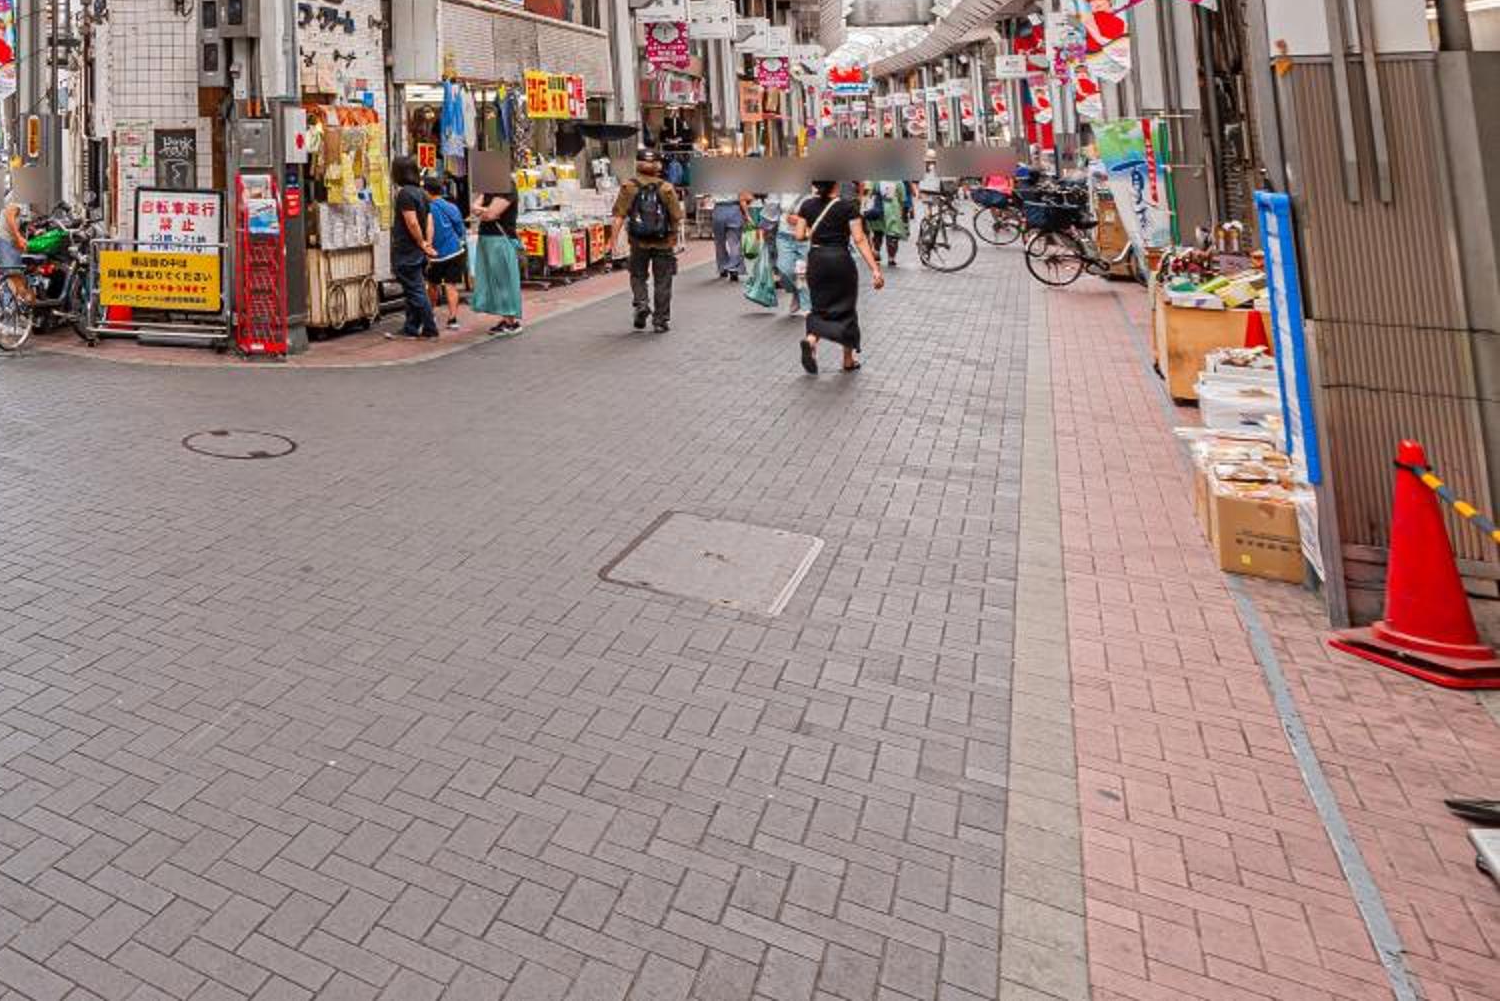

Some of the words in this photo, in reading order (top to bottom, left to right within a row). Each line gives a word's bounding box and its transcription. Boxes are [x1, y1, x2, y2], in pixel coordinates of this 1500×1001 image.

[141, 200, 215, 216] 自転車走行
